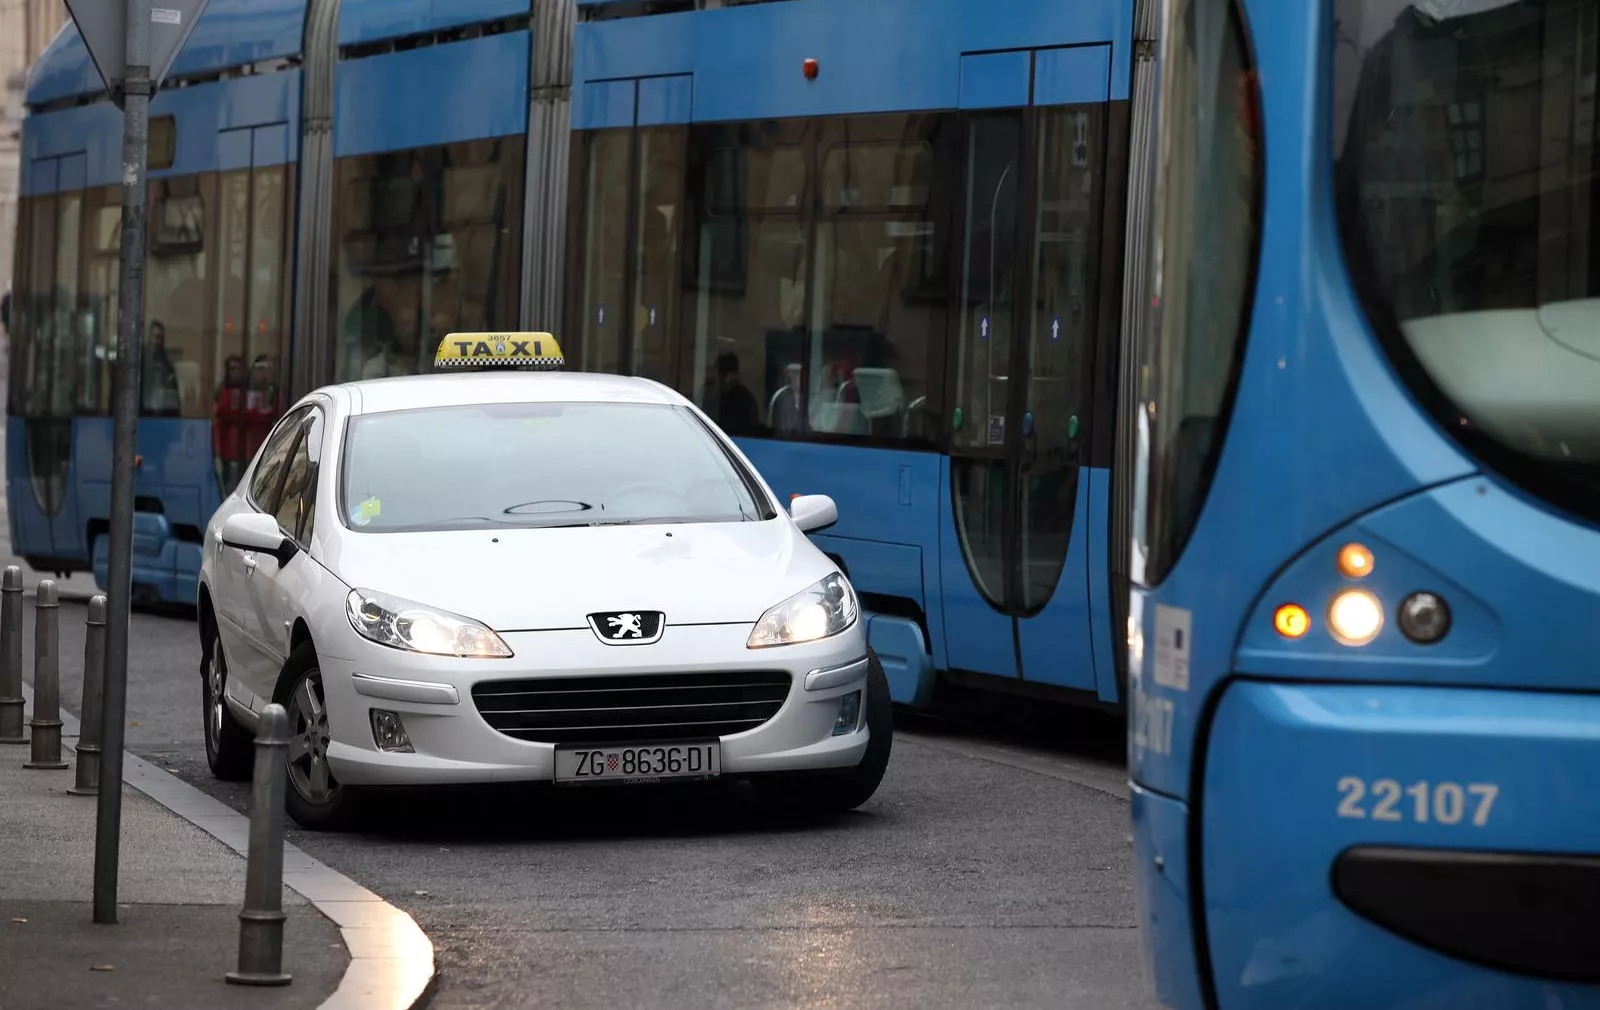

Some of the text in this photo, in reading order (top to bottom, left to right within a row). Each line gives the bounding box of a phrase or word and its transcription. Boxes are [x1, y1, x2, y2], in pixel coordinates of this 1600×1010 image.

[453, 341, 543, 357] TAXI
[575, 746, 713, 776] ZG 8636-DI
[1336, 775, 1499, 827] 22107
